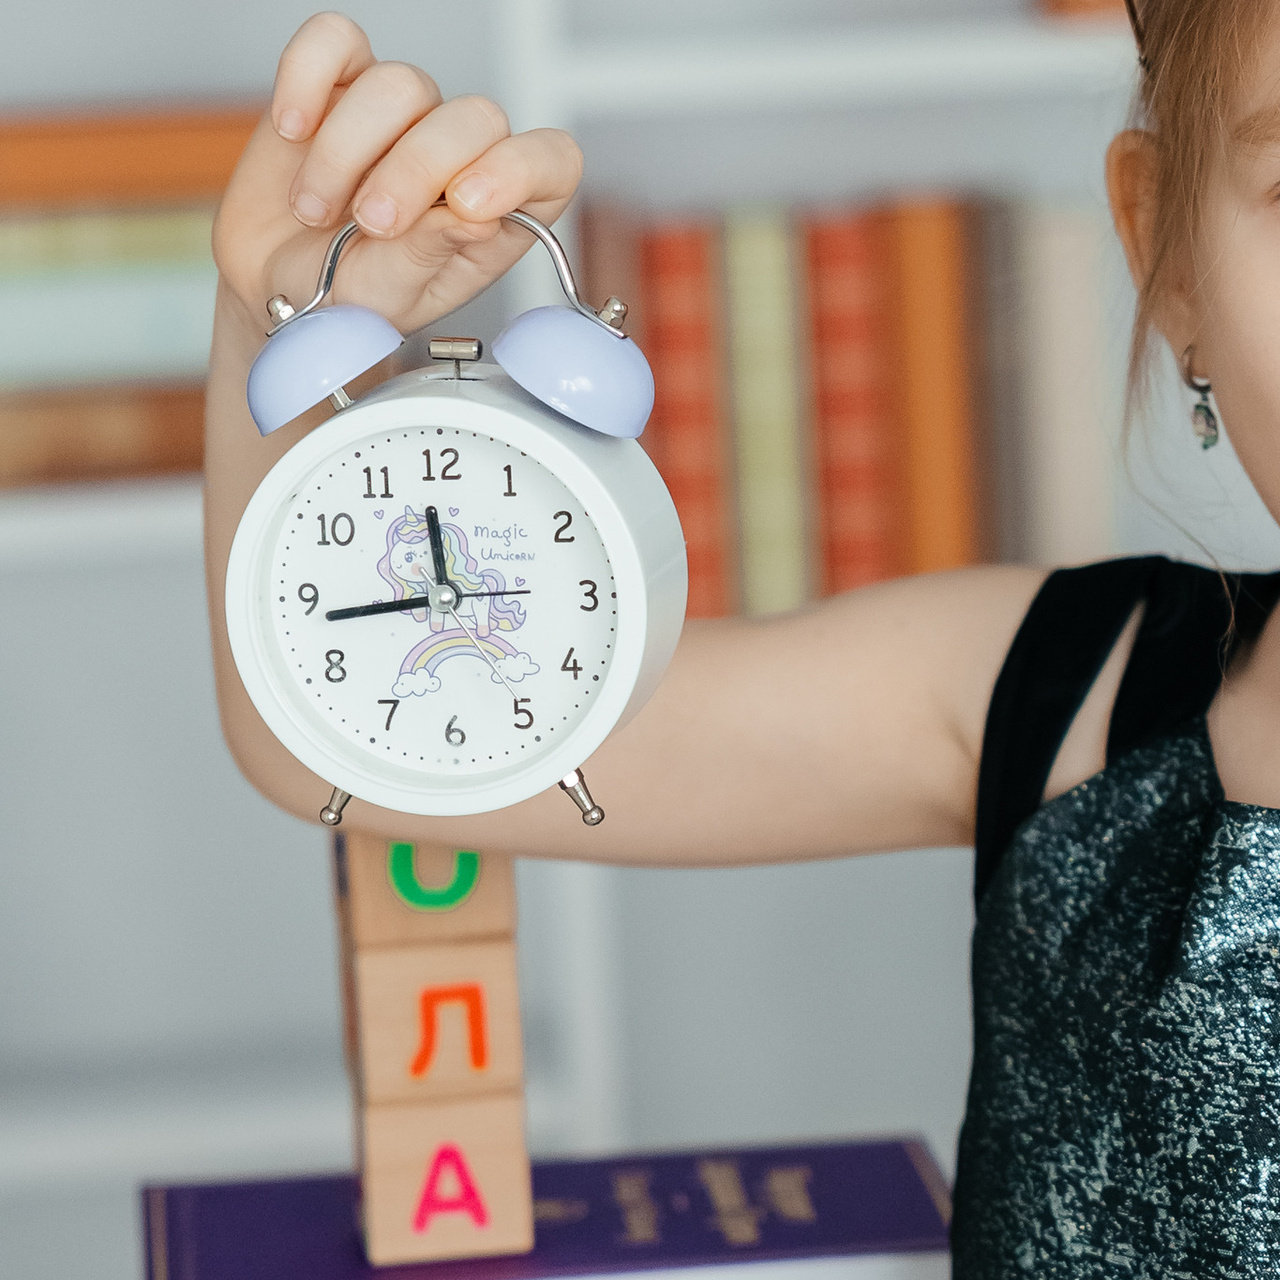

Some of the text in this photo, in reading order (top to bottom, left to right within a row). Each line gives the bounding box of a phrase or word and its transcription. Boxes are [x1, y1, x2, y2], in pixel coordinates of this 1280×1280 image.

[422, 447, 462, 482] 12
[503, 465, 517, 497] 1
[362, 466, 394, 499] 11
[316, 512, 356, 547] 10
[553, 510, 575, 543] 2
[298, 582, 320, 616] 9
[579, 579, 599, 612] 3
[324, 649, 347, 684] 8
[560, 647, 583, 681] 4
[377, 699, 400, 732] 7
[444, 714, 467, 747] 6
[513, 698, 535, 730] 5
